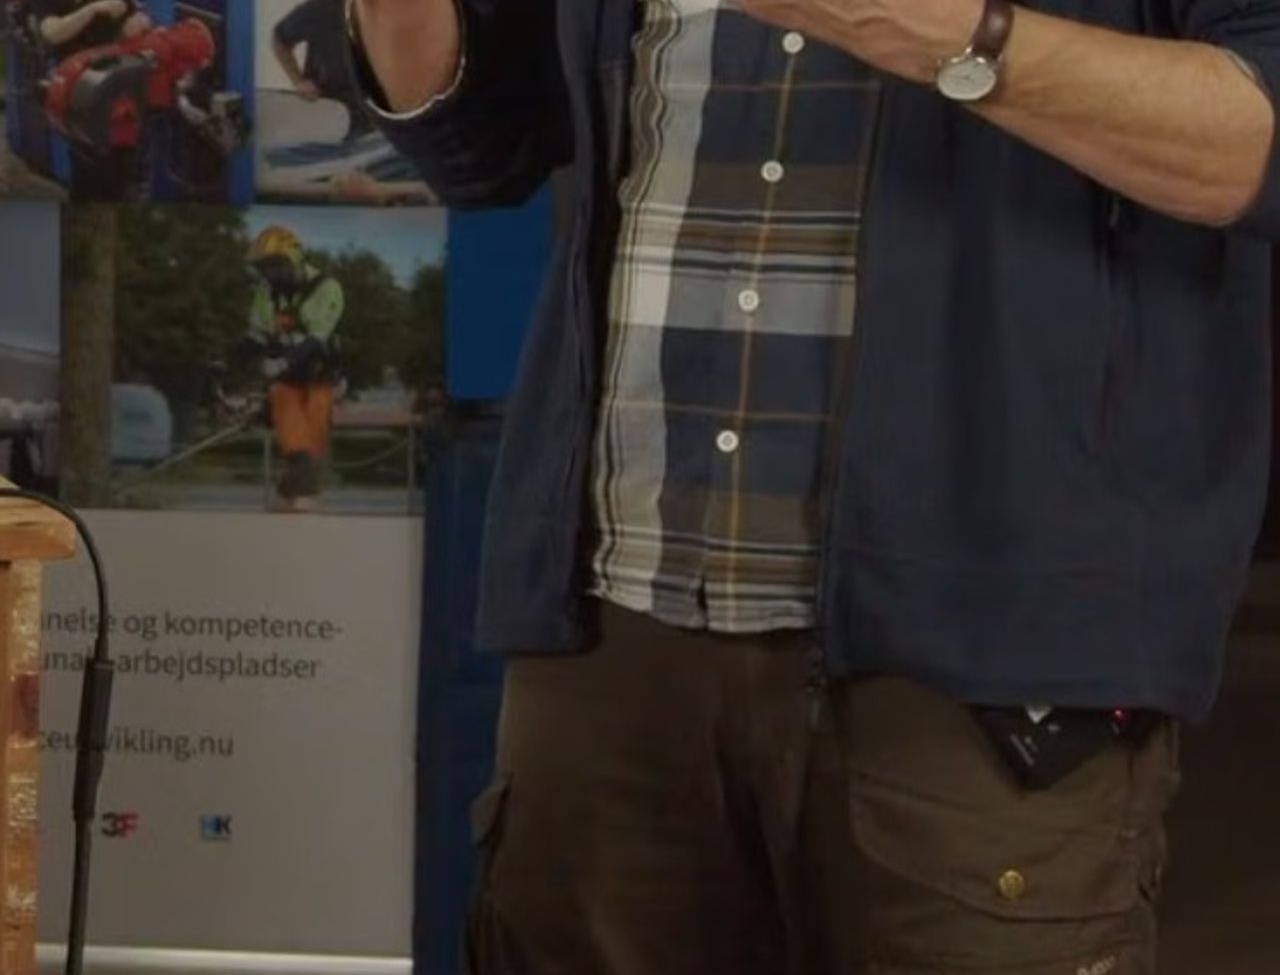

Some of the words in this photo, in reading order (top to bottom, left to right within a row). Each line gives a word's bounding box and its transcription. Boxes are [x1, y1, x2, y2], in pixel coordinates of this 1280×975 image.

[122, 614, 159, 642] og
[164, 608, 344, 644] kompetence-
[118, 648, 319, 683] arbejdspladser
